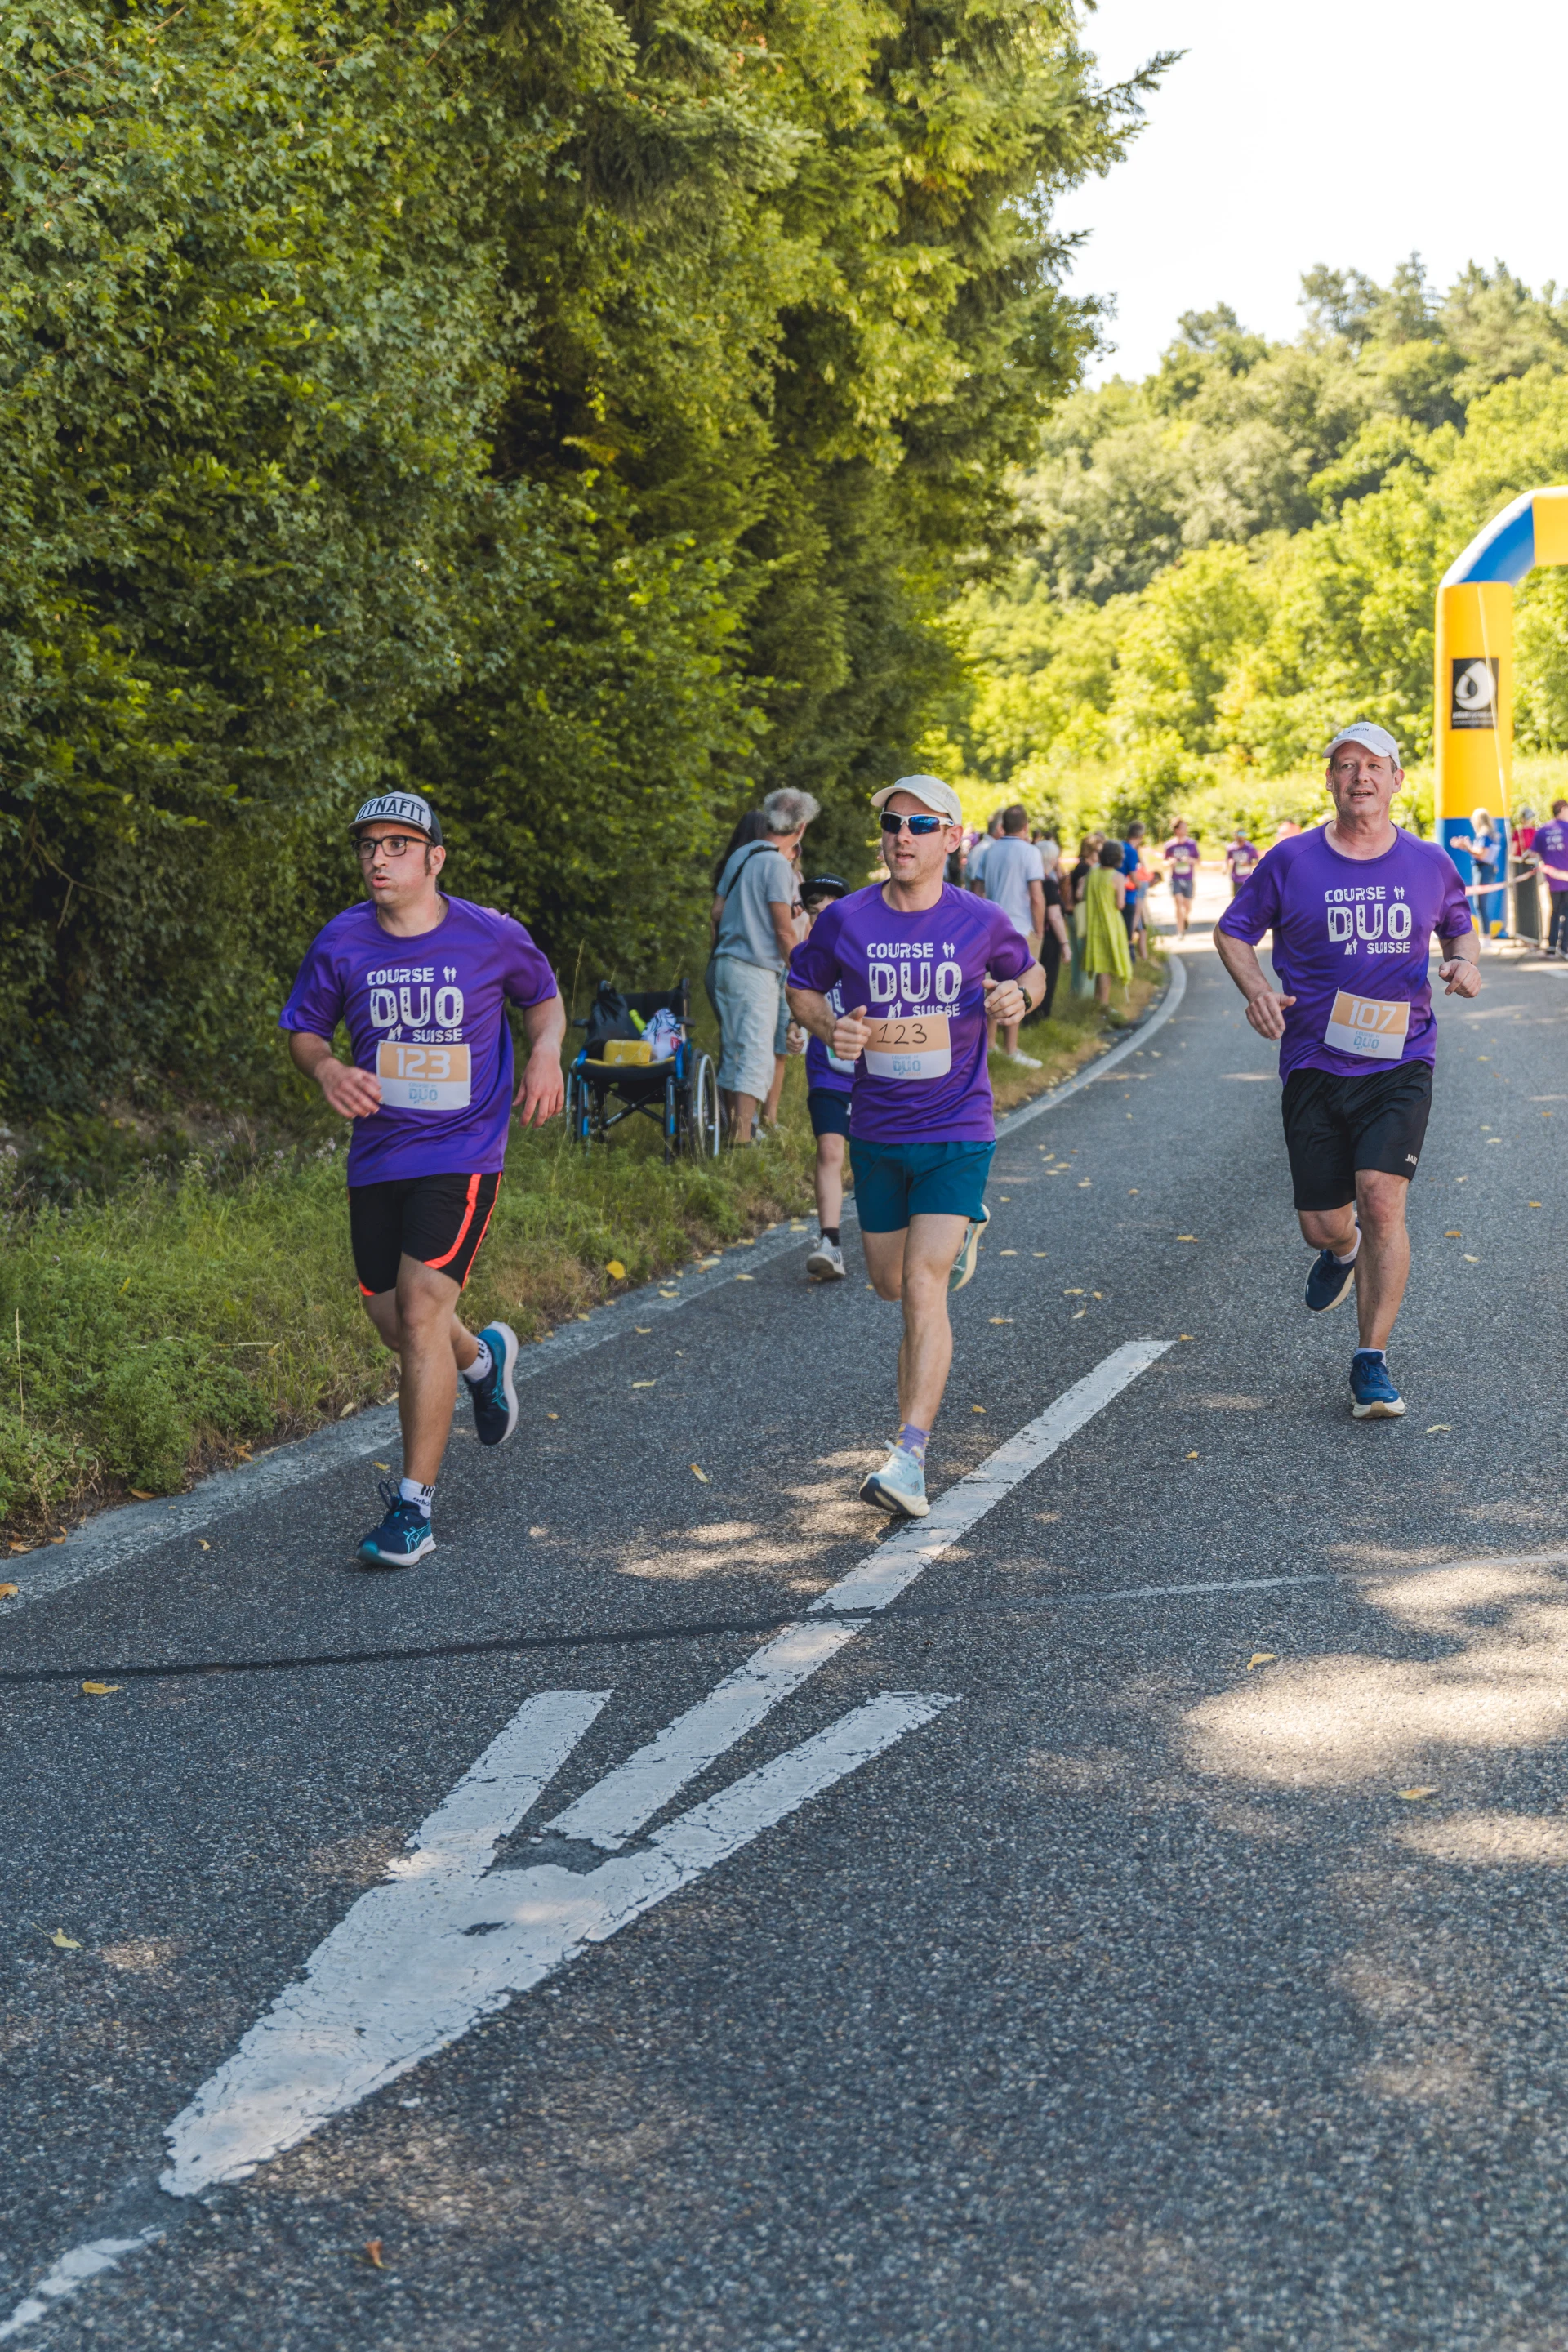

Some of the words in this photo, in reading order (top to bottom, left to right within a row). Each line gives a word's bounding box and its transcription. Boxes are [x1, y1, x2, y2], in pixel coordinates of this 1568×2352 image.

[359, 799, 425, 821] DYNAFIT
[1325, 886, 1386, 903] COURSE
[1327, 902, 1412, 942] DUO
[866, 942, 934, 958] COURSE
[1366, 942, 1411, 955] SUISSE
[367, 967, 434, 987] COURSE
[868, 961, 963, 1003] DUO
[369, 986, 465, 1028] DUO
[911, 1003, 960, 1018] SUISSE
[1348, 1000, 1397, 1031] 107
[412, 1028, 463, 1043] SUISSE
[876, 1022, 928, 1045] 123
[1353, 1036, 1380, 1049] DUO
[396, 1048, 451, 1080] 123
[893, 1060, 922, 1072] DUO
[408, 1088, 439, 1101] DUO
